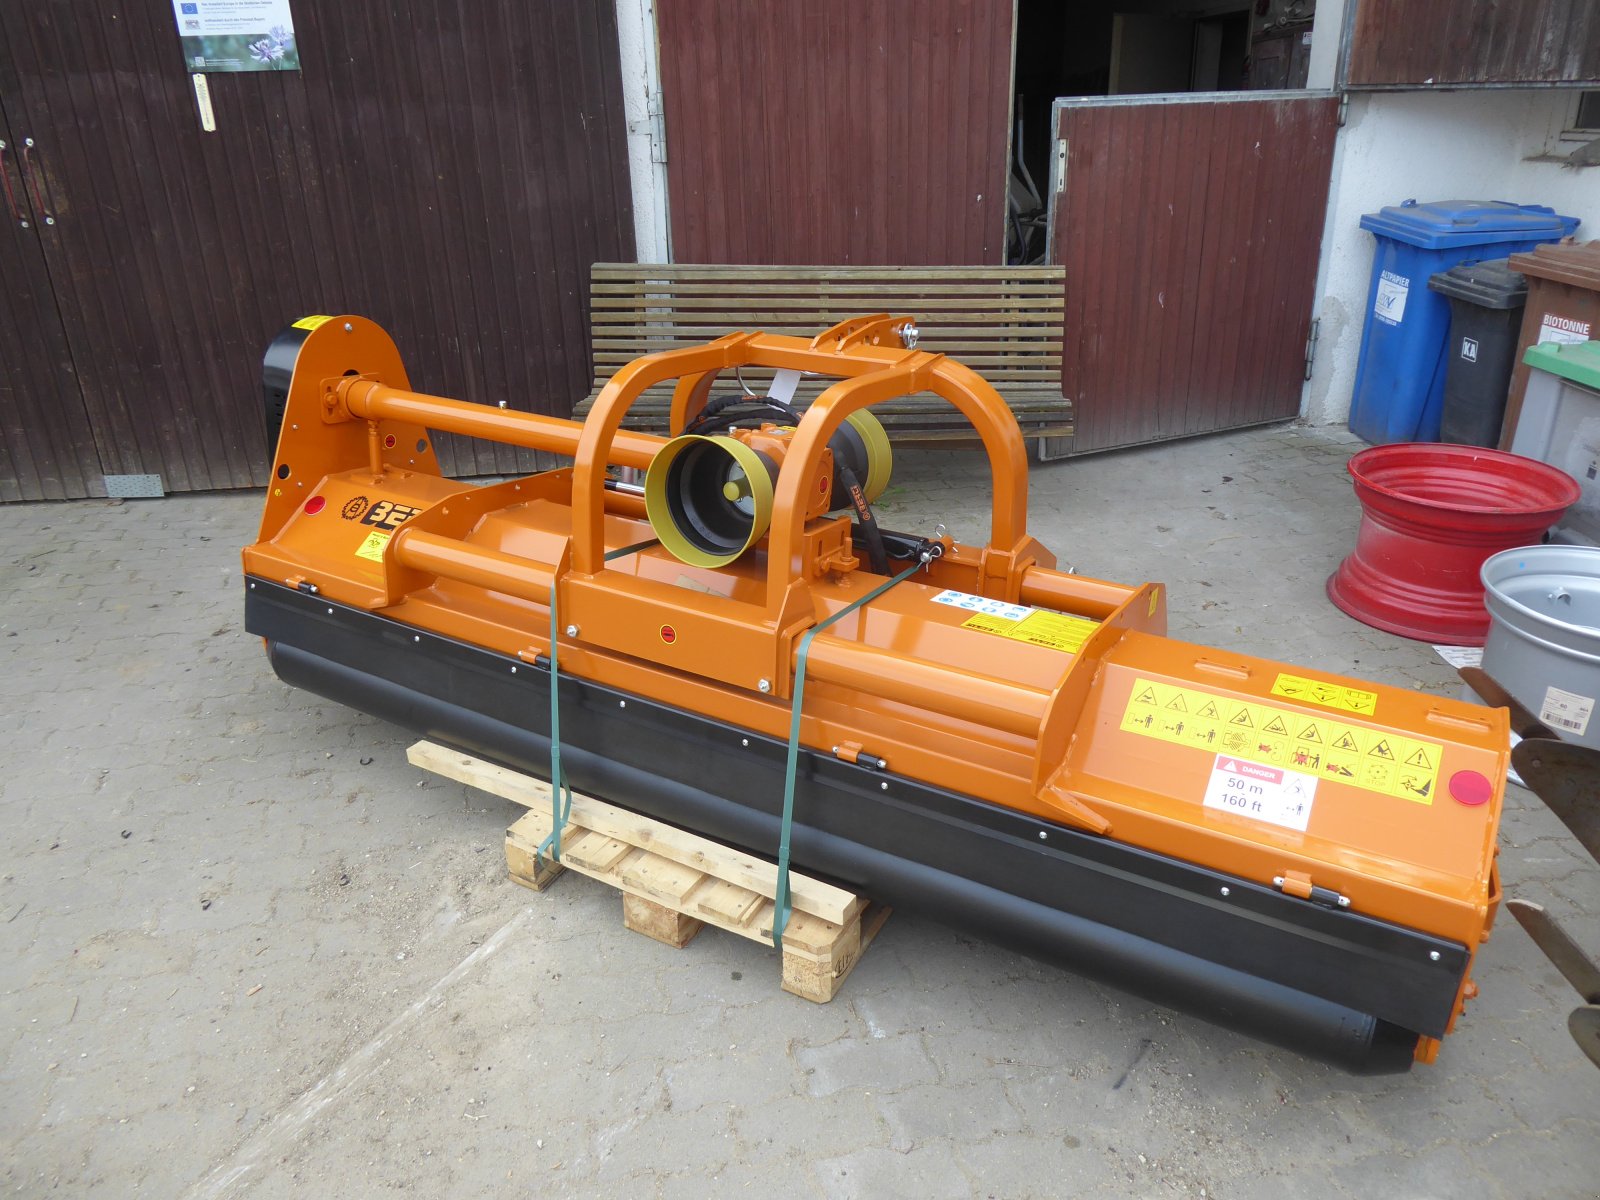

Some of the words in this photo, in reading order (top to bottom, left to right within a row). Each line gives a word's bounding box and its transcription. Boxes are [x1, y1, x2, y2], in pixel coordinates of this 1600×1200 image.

[1380, 269, 1410, 288] ALTPAPIER
[1543, 314, 1590, 334] BIOTONNE
[1463, 341, 1476, 358] KA
[1242, 765, 1276, 779] DANGER
[1227, 777, 1245, 790] 50
[1249, 785, 1263, 795] m
[1221, 793, 1247, 808] 160
[1251, 801, 1263, 812] ft
